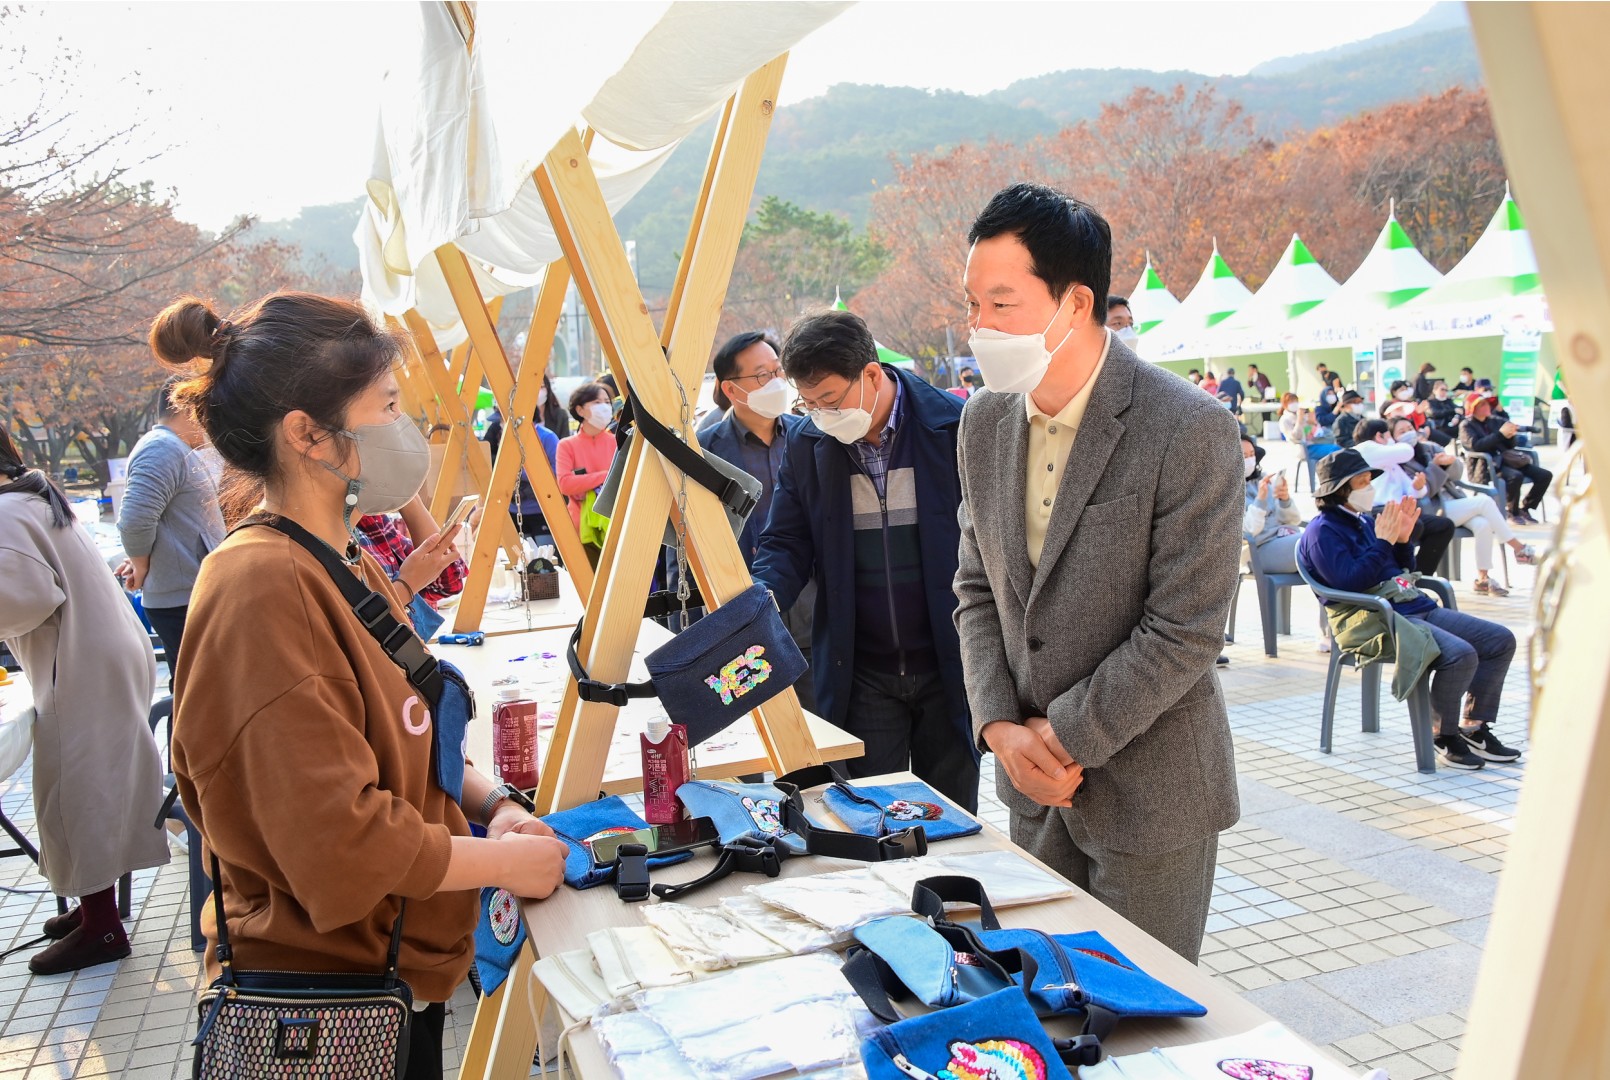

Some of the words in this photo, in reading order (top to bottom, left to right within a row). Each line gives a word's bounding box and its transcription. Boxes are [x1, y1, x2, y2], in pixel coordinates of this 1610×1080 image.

[704, 645, 772, 705] YES
[649, 779, 660, 811] WATER
[658, 777, 670, 805] DEEP
